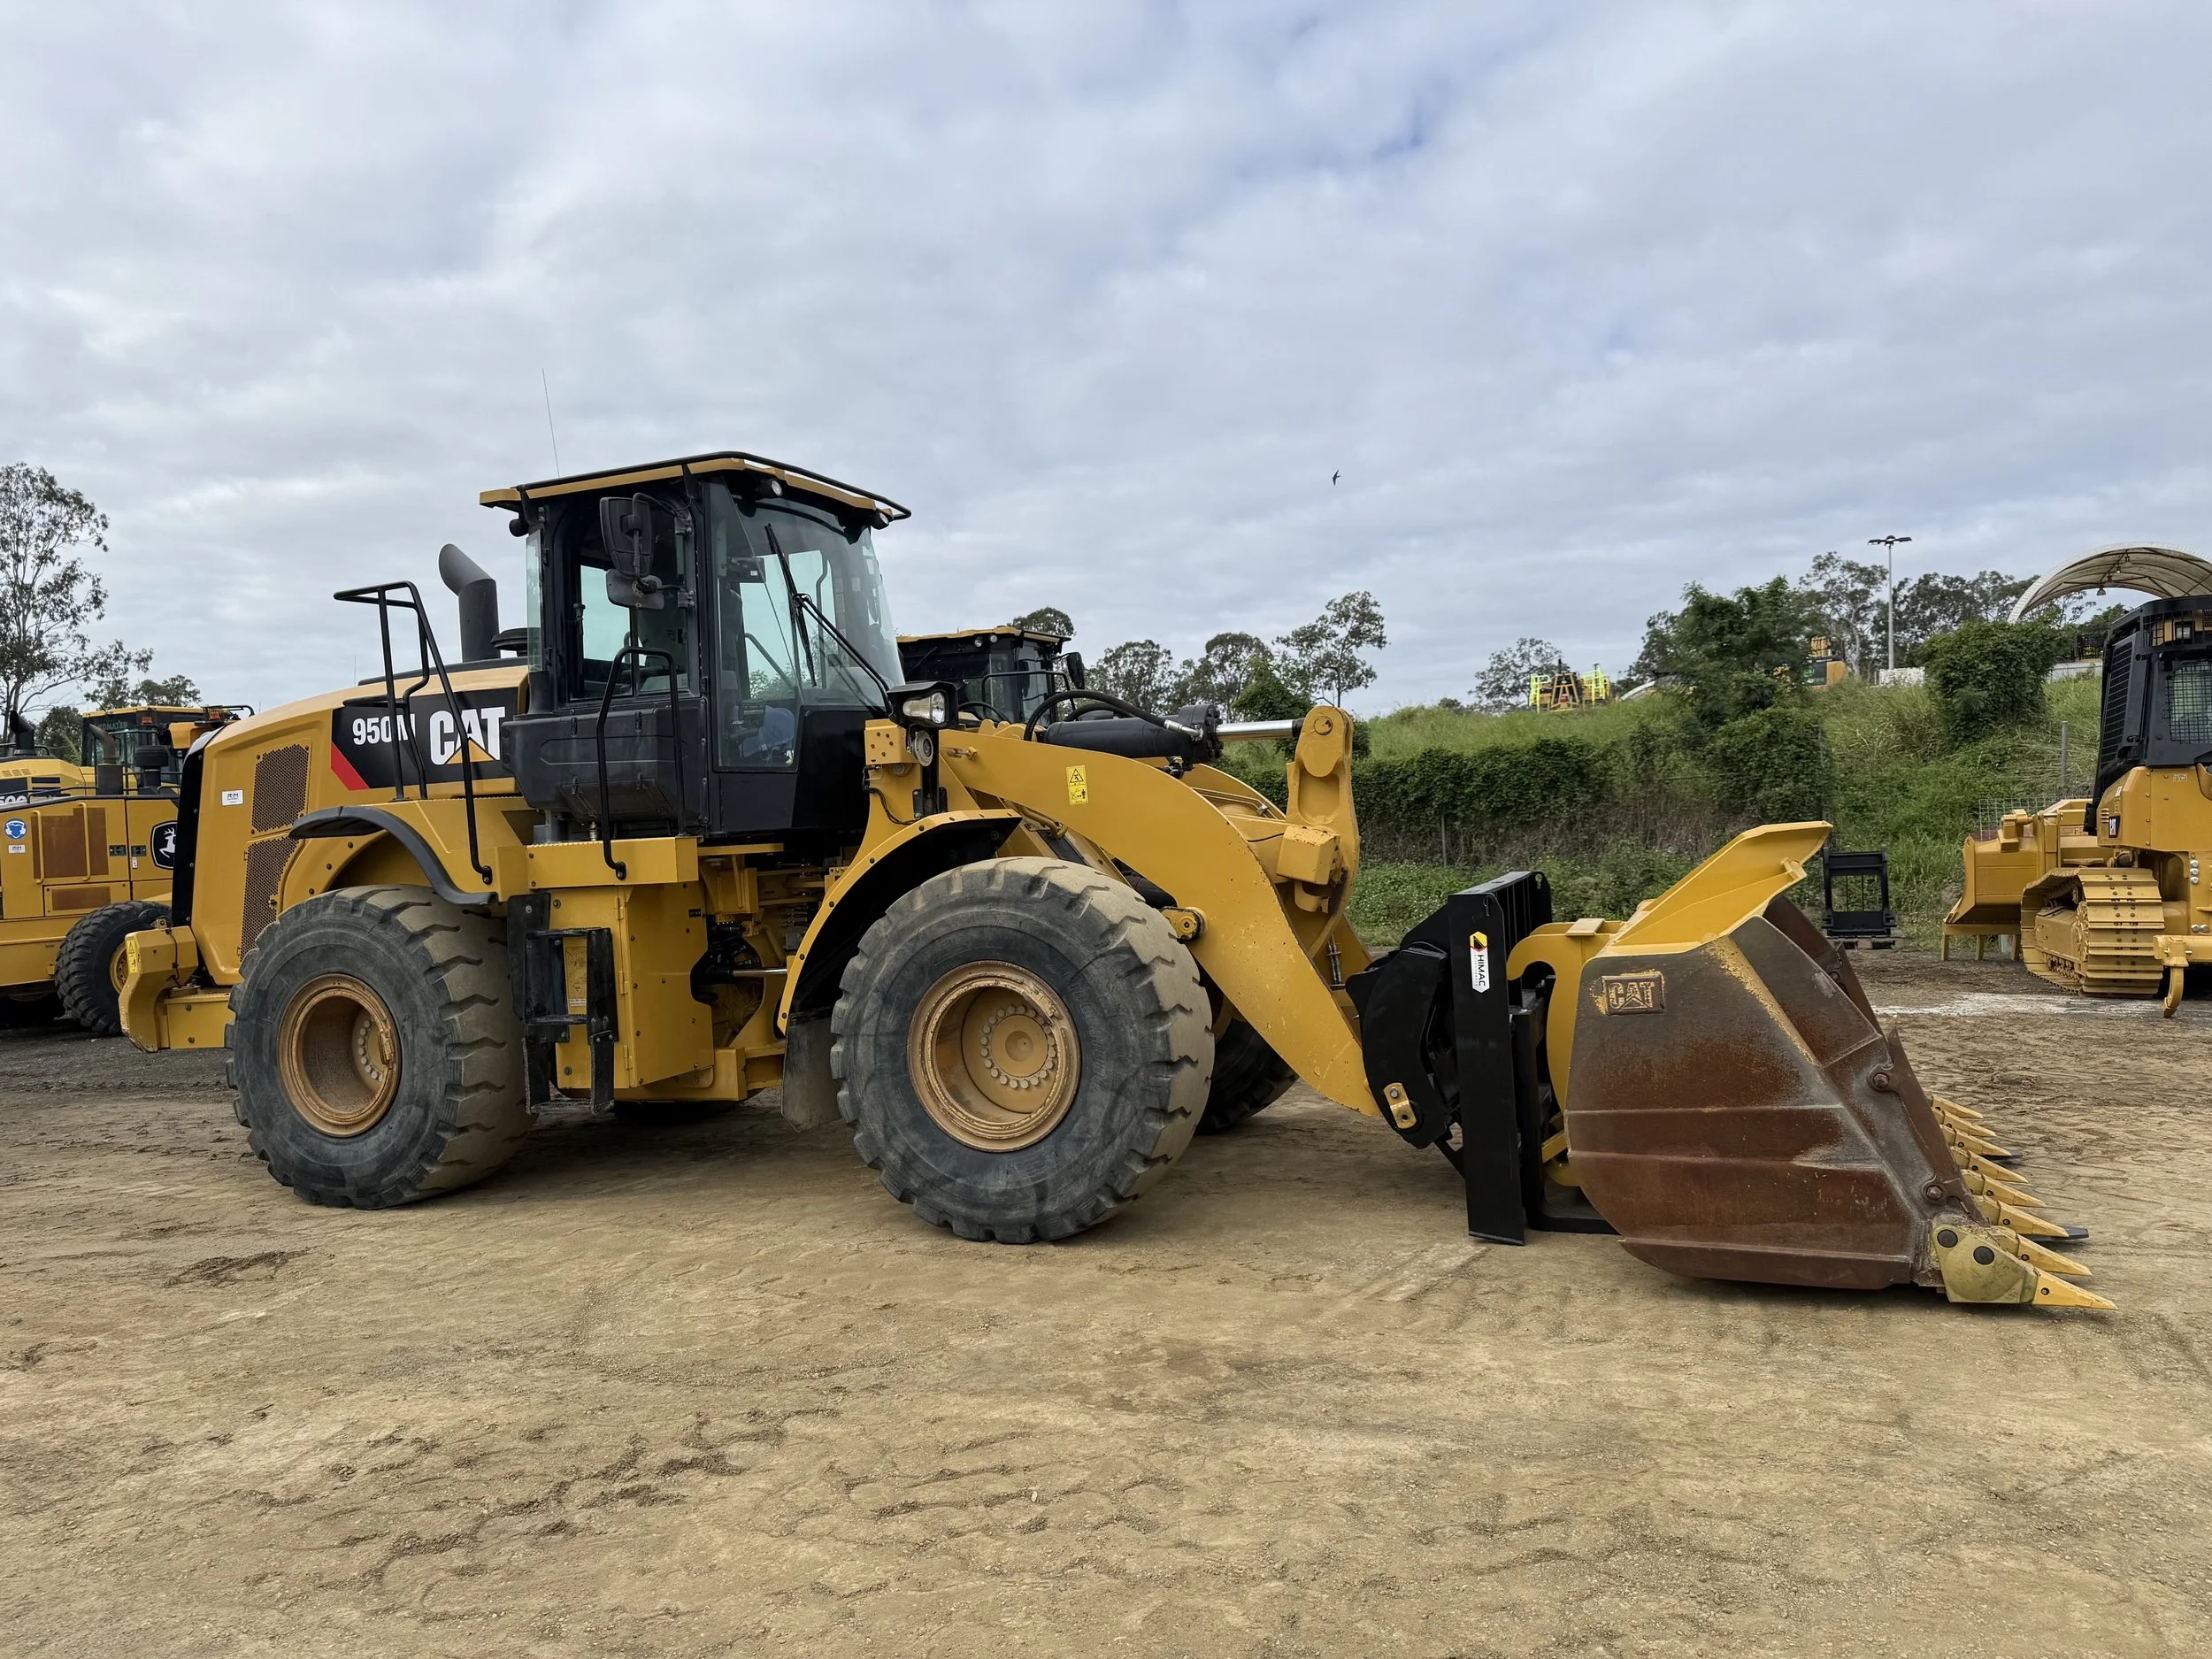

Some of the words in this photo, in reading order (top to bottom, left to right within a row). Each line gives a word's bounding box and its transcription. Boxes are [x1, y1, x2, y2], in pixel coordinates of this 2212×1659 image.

[429, 707, 505, 765] CAT
[1477, 954, 1486, 987] HIMAC
[1608, 980, 1655, 1010] CAT
